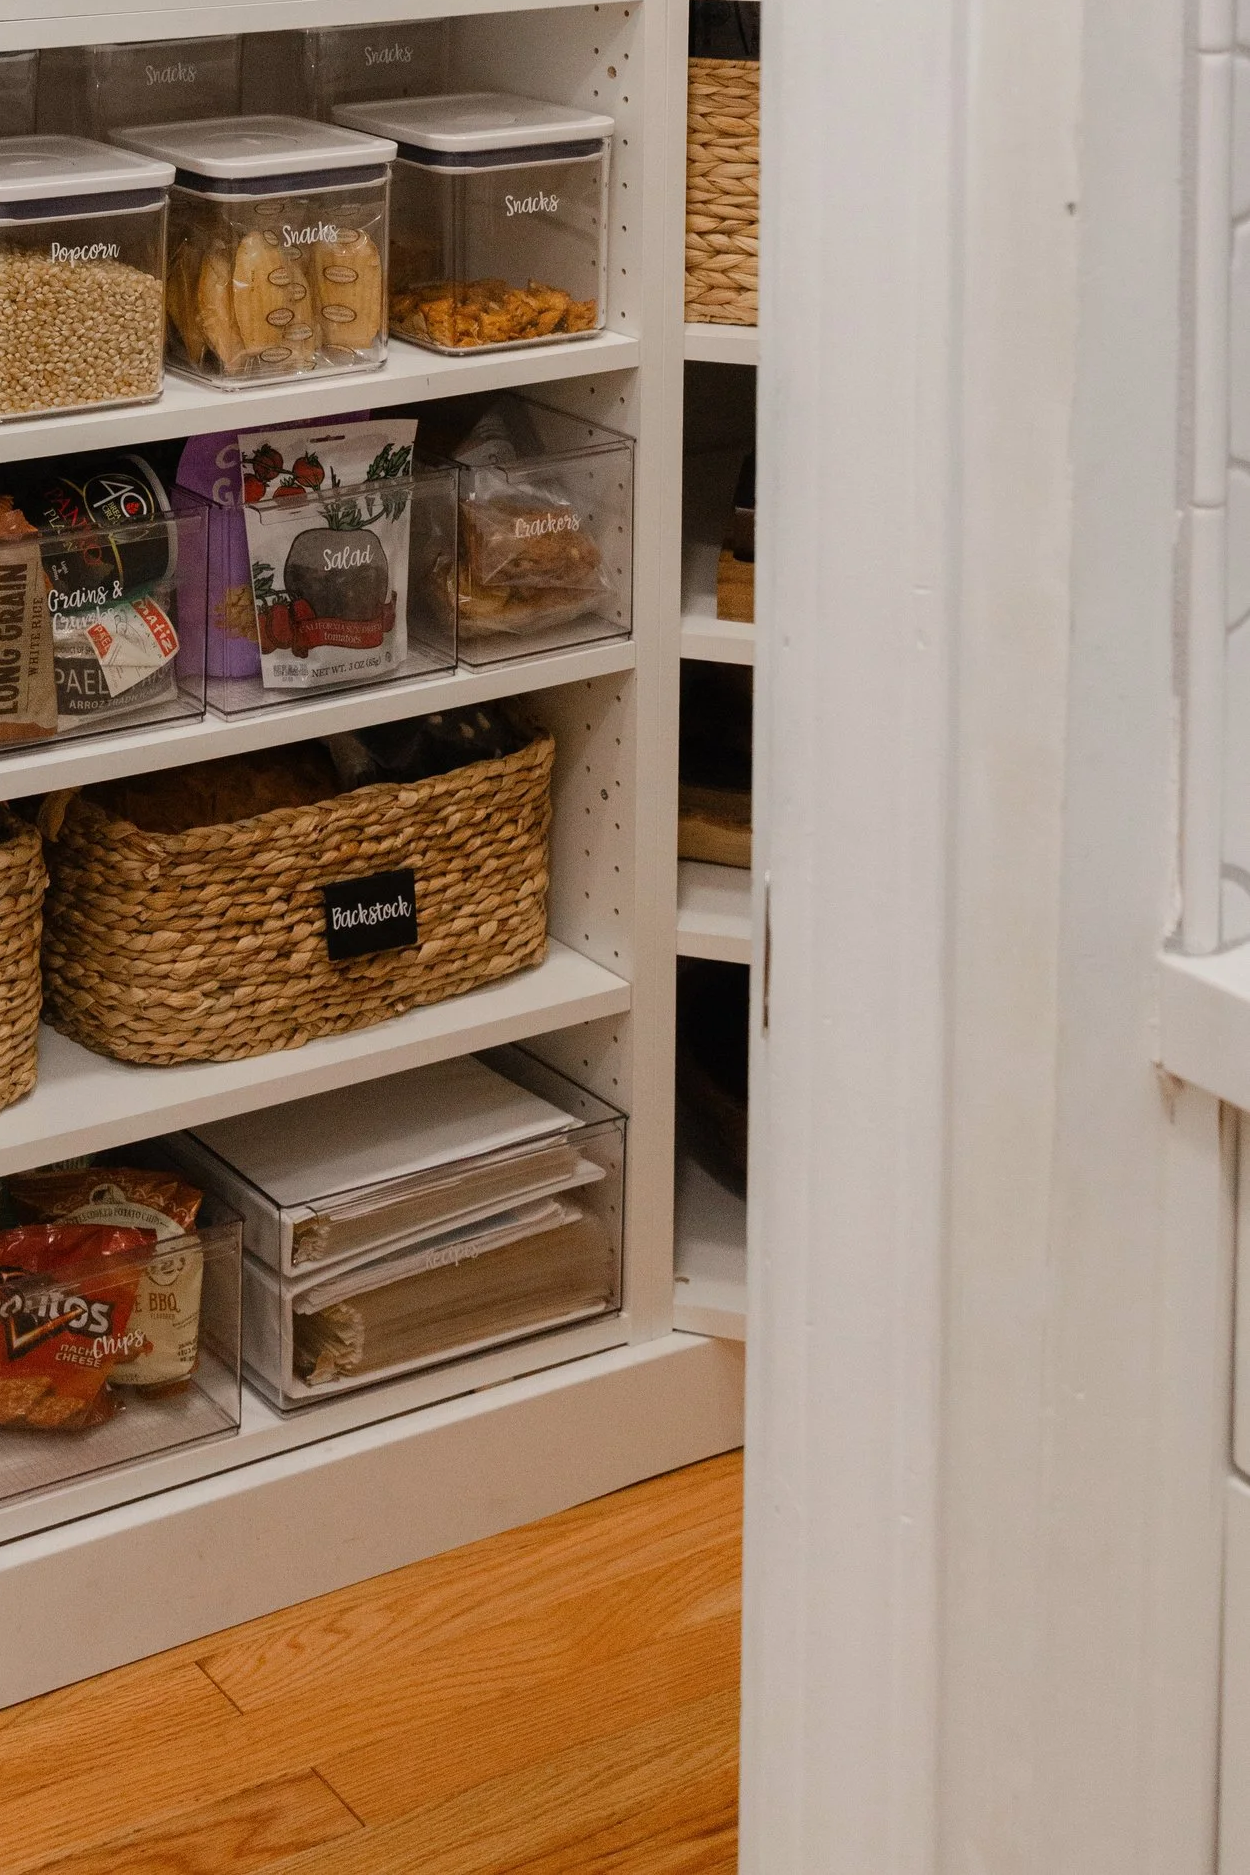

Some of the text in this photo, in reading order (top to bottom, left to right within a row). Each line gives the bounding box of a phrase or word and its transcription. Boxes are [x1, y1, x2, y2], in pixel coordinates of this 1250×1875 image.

[364, 43, 414, 66] Snacks
[144, 62, 197, 86] Snacks
[505, 191, 560, 217] Snacks
[282, 221, 338, 247] Snacks
[51, 242, 121, 268] Popcorn
[514, 513, 581, 539] Crackers
[323, 544, 375, 572] Salad
[48, 580, 123, 612] Grains &
[28, 597, 43, 677] WHITE RICE
[324, 632, 362, 644] tomatoes
[311, 668, 329, 678] NET
[331, 665, 347, 674] WT.
[69, 700, 105, 709] ARROZ
[332, 895, 412, 930] Backstock
[113, 1208, 140, 1219] POTATO
[149, 1292, 181, 1313] BBQ
[93, 1329, 146, 1359] Chips
[55, 1352, 101, 1368] CHEESE
